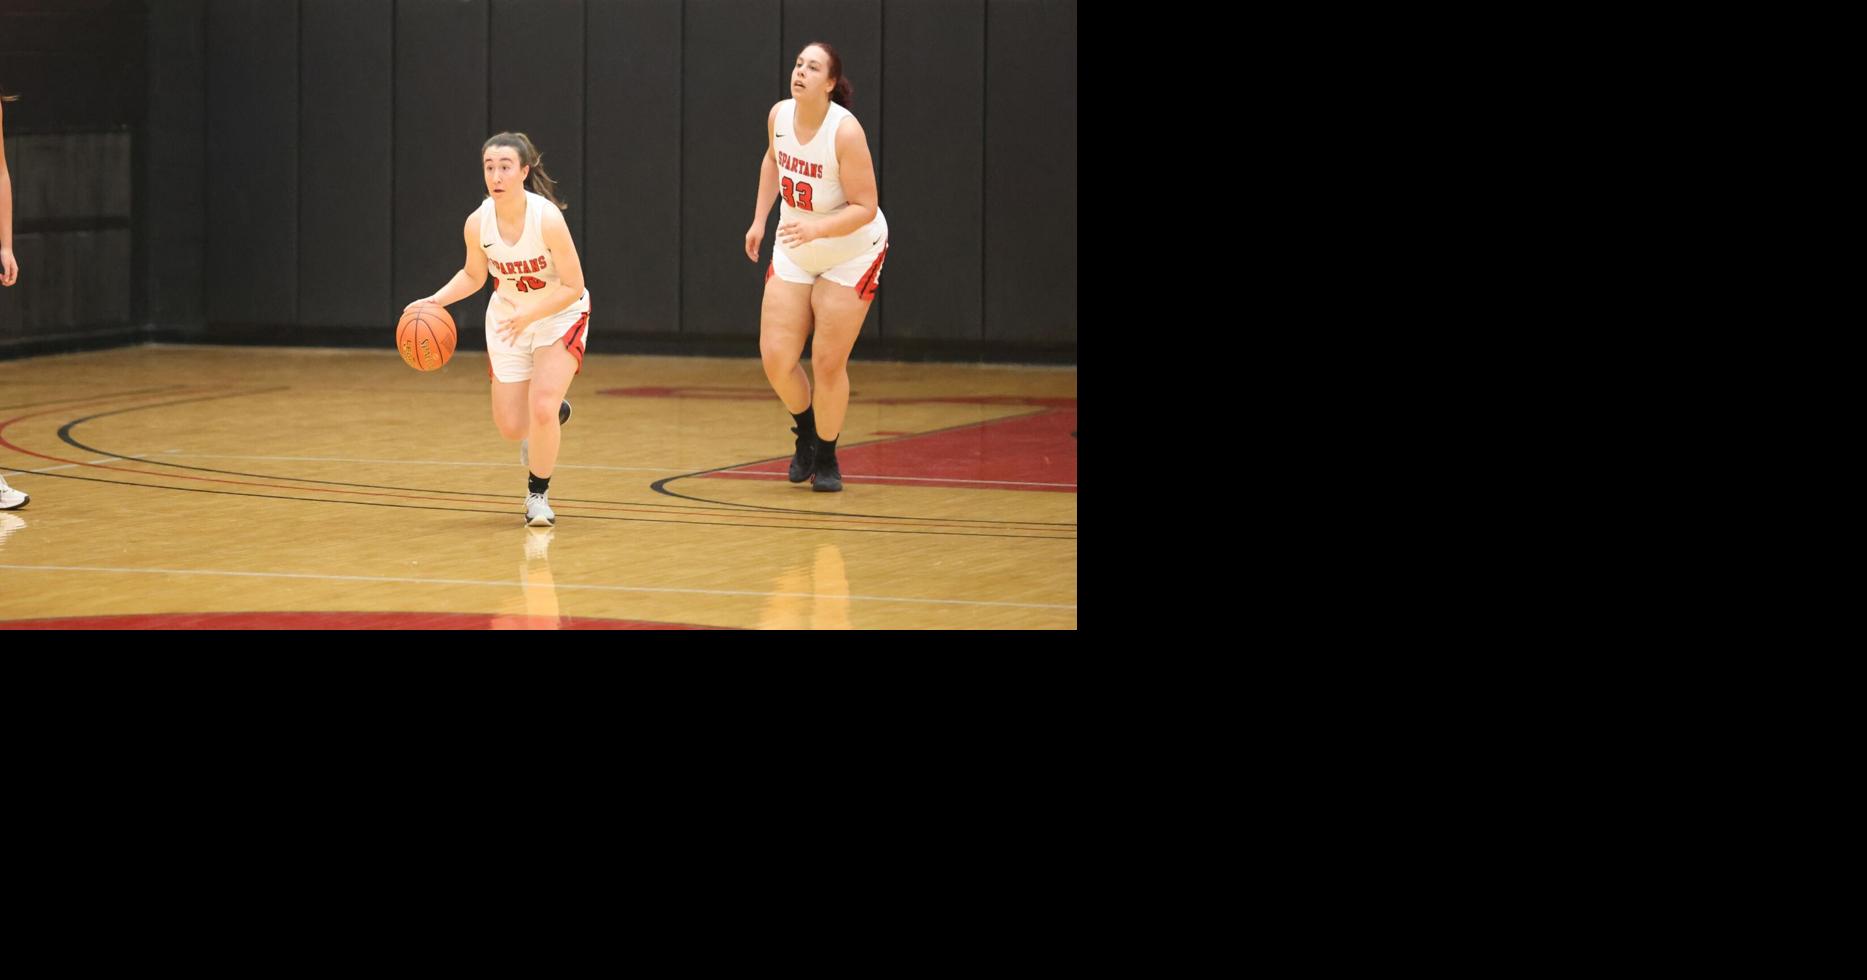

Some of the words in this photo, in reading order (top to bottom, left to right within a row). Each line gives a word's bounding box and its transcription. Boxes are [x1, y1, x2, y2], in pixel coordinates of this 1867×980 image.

[778, 151, 823, 179] SPARTANS
[781, 176, 813, 211] 33
[489, 256, 547, 274] PARTANS
